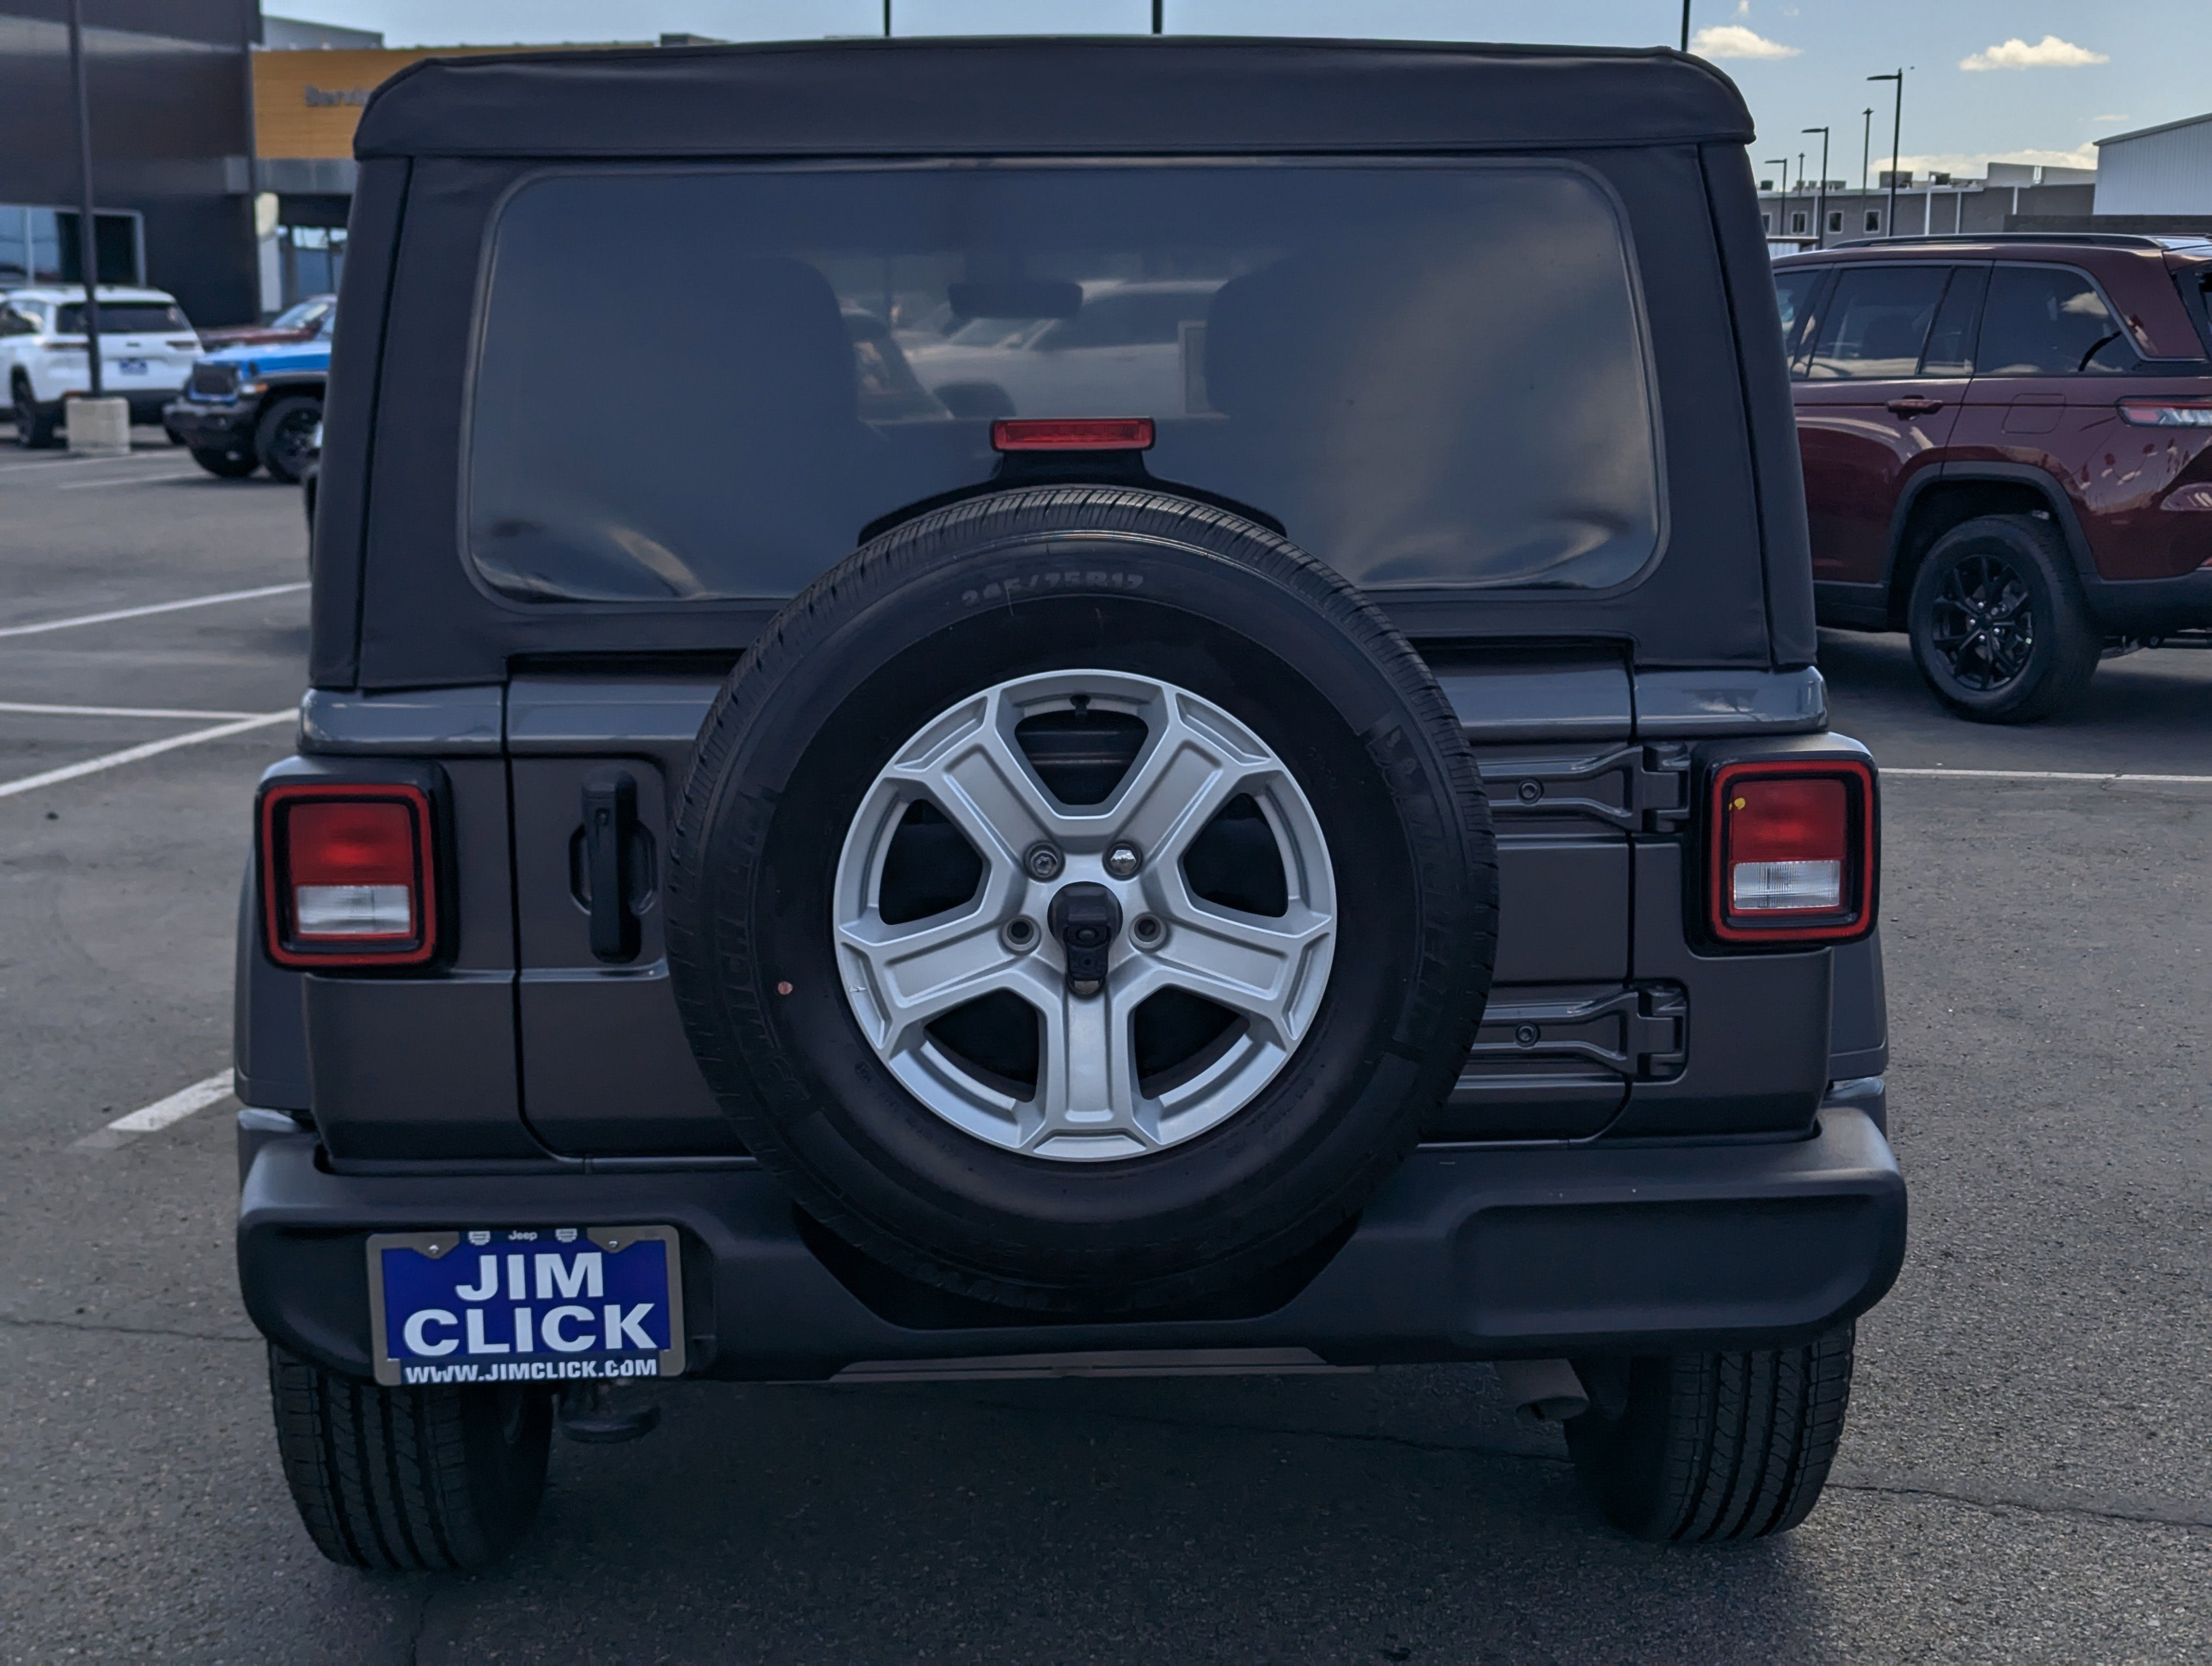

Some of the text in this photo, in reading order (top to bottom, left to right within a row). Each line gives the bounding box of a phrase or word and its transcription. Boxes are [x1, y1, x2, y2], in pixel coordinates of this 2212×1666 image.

[507, 1229, 538, 1241] Jeep
[455, 1252, 604, 1300] JIM
[403, 1303, 658, 1356] CLICK
[405, 1359, 657, 1384] WWW.JIMCLICK.COM
